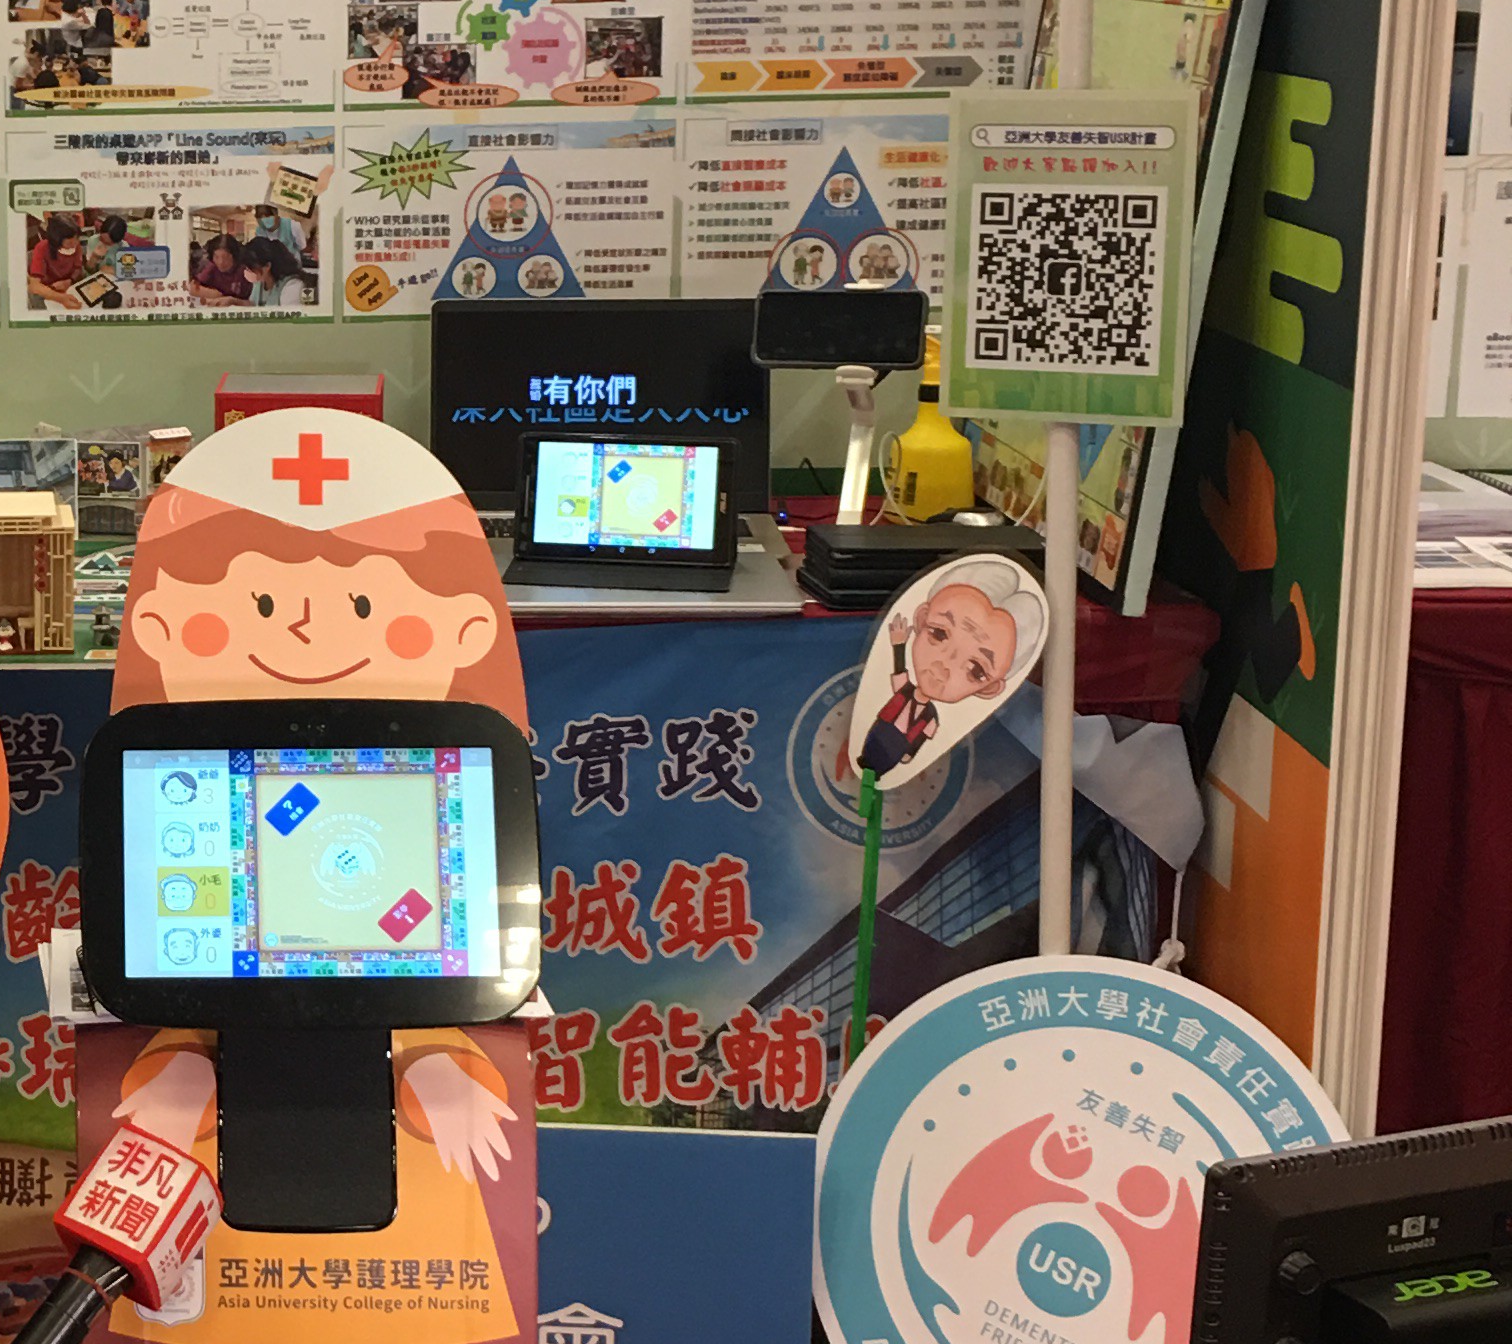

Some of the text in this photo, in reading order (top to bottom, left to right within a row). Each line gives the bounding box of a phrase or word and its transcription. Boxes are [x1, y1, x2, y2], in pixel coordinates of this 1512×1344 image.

[202, 788, 214, 805] 3
[861, 818, 935, 846] IVERSITY
[544, 853, 764, 964] 城鎮
[527, 998, 888, 1114] 智能輔
[1076, 1088, 1187, 1154] 友善失智
[107, 1137, 180, 1201] 非凡
[79, 1179, 162, 1243] 新聞
[218, 1257, 491, 1292] 亞洲大學護理學院
[1028, 1240, 1104, 1301] USR
[1393, 1269, 1499, 1302] acer
[217, 1294, 490, 1315] Asia University College of Nursing
